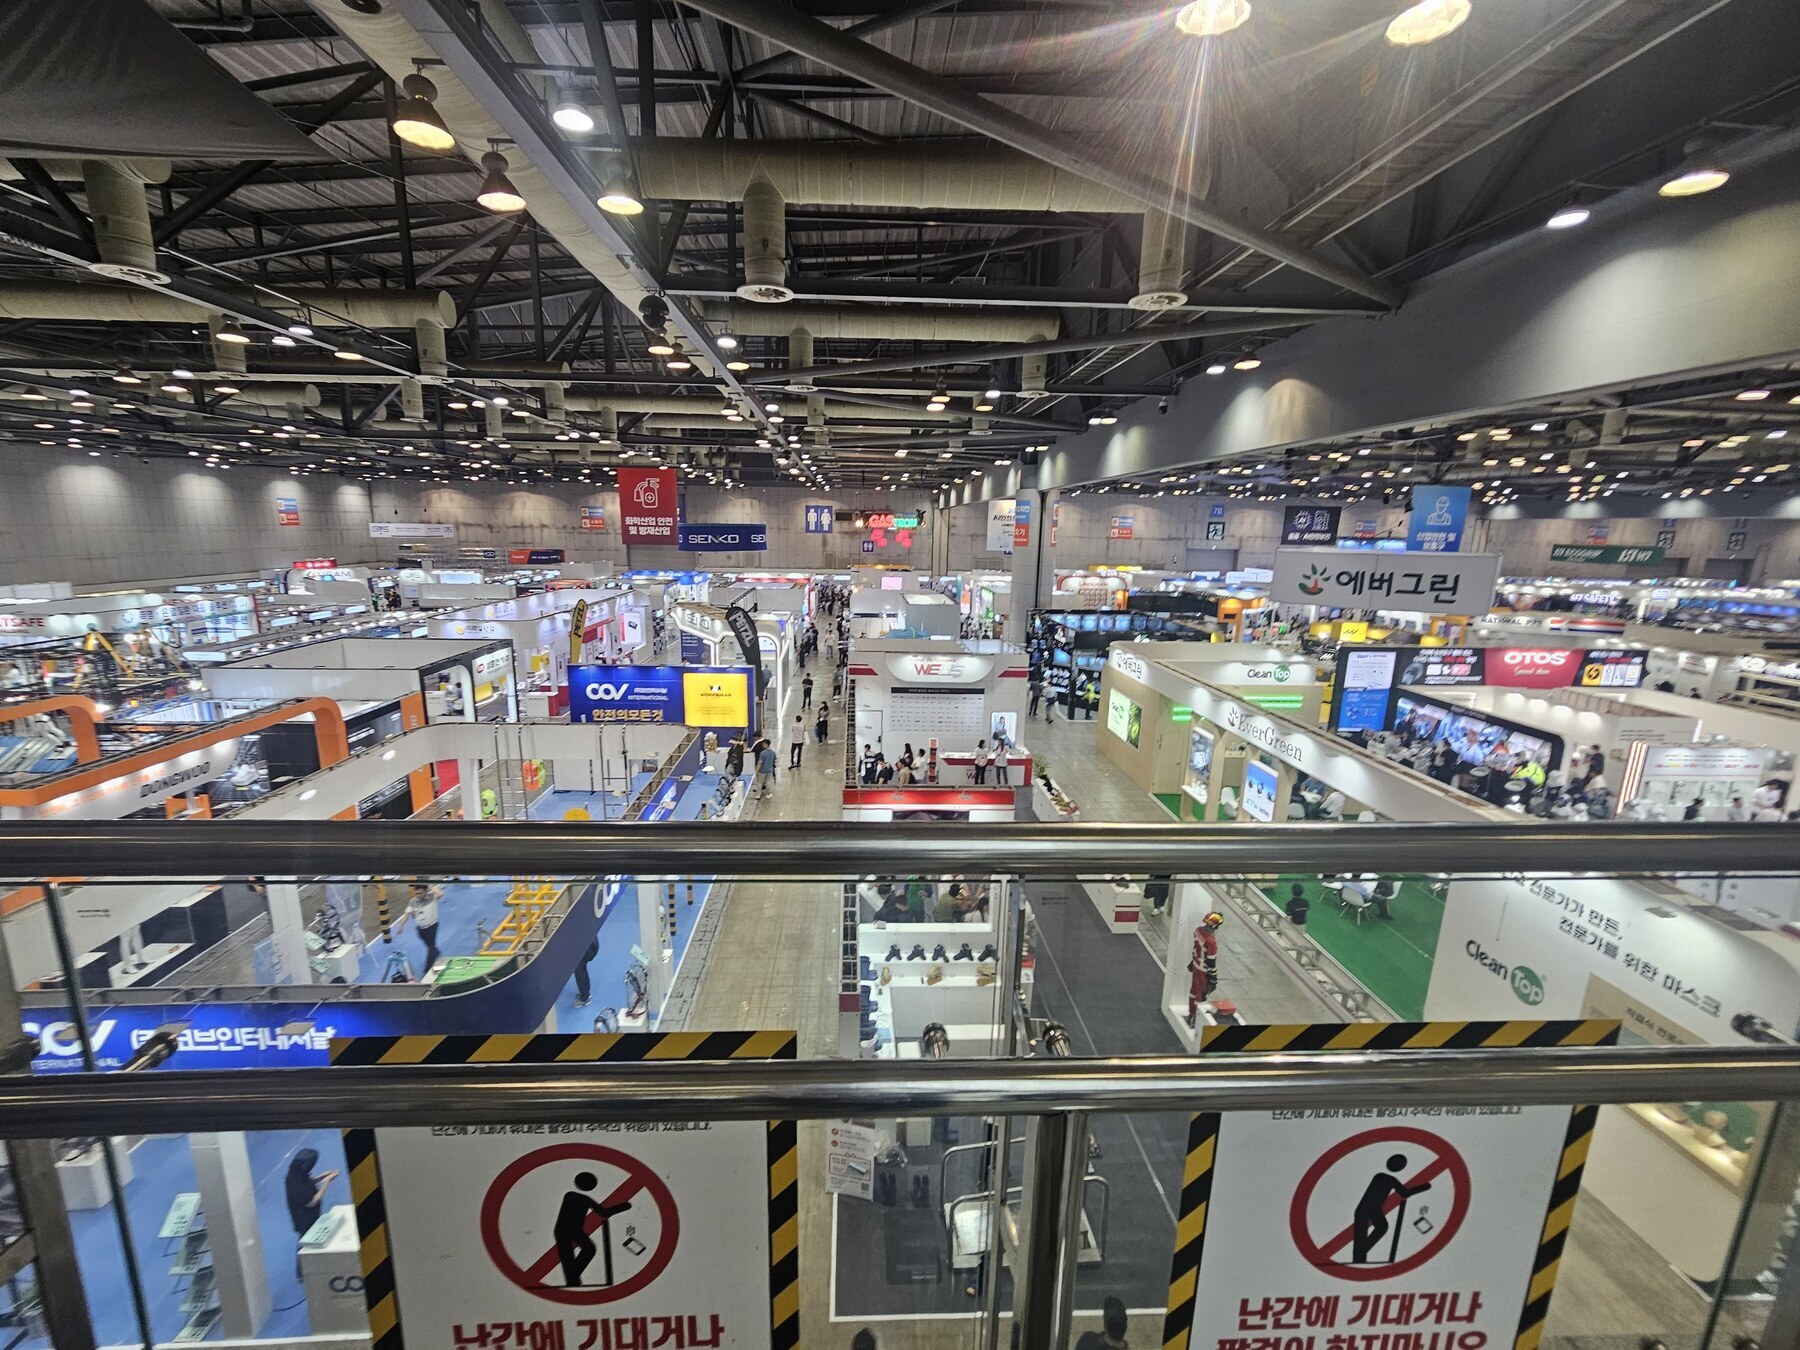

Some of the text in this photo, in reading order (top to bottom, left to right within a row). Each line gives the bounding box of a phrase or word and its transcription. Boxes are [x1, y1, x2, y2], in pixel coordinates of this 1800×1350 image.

[625, 517, 673, 526] 화학산업 안전
[629, 526, 638, 535] 및
[688, 534, 740, 544] SENKO
[1336, 570, 1461, 604] 에버그린
[0, 617, 44, 627] TSAFE
[728, 610, 756, 648] PETZL
[1504, 651, 1567, 665] OTOS
[1247, 668, 1290, 681] Clean Top
[585, 683, 629, 701] COV
[592, 709, 664, 722] 안전의모든것
[1238, 714, 1302, 762] EverGreen
[139, 762, 211, 798] DONGWOO
[1465, 939, 1544, 1004] Clean Top
[1559, 915, 1723, 1018] 전문가를 위한 마스크
[1238, 1290, 1483, 1331] 난간에 기대거나
[452, 1313, 725, 1350] 난간에 기대거나
